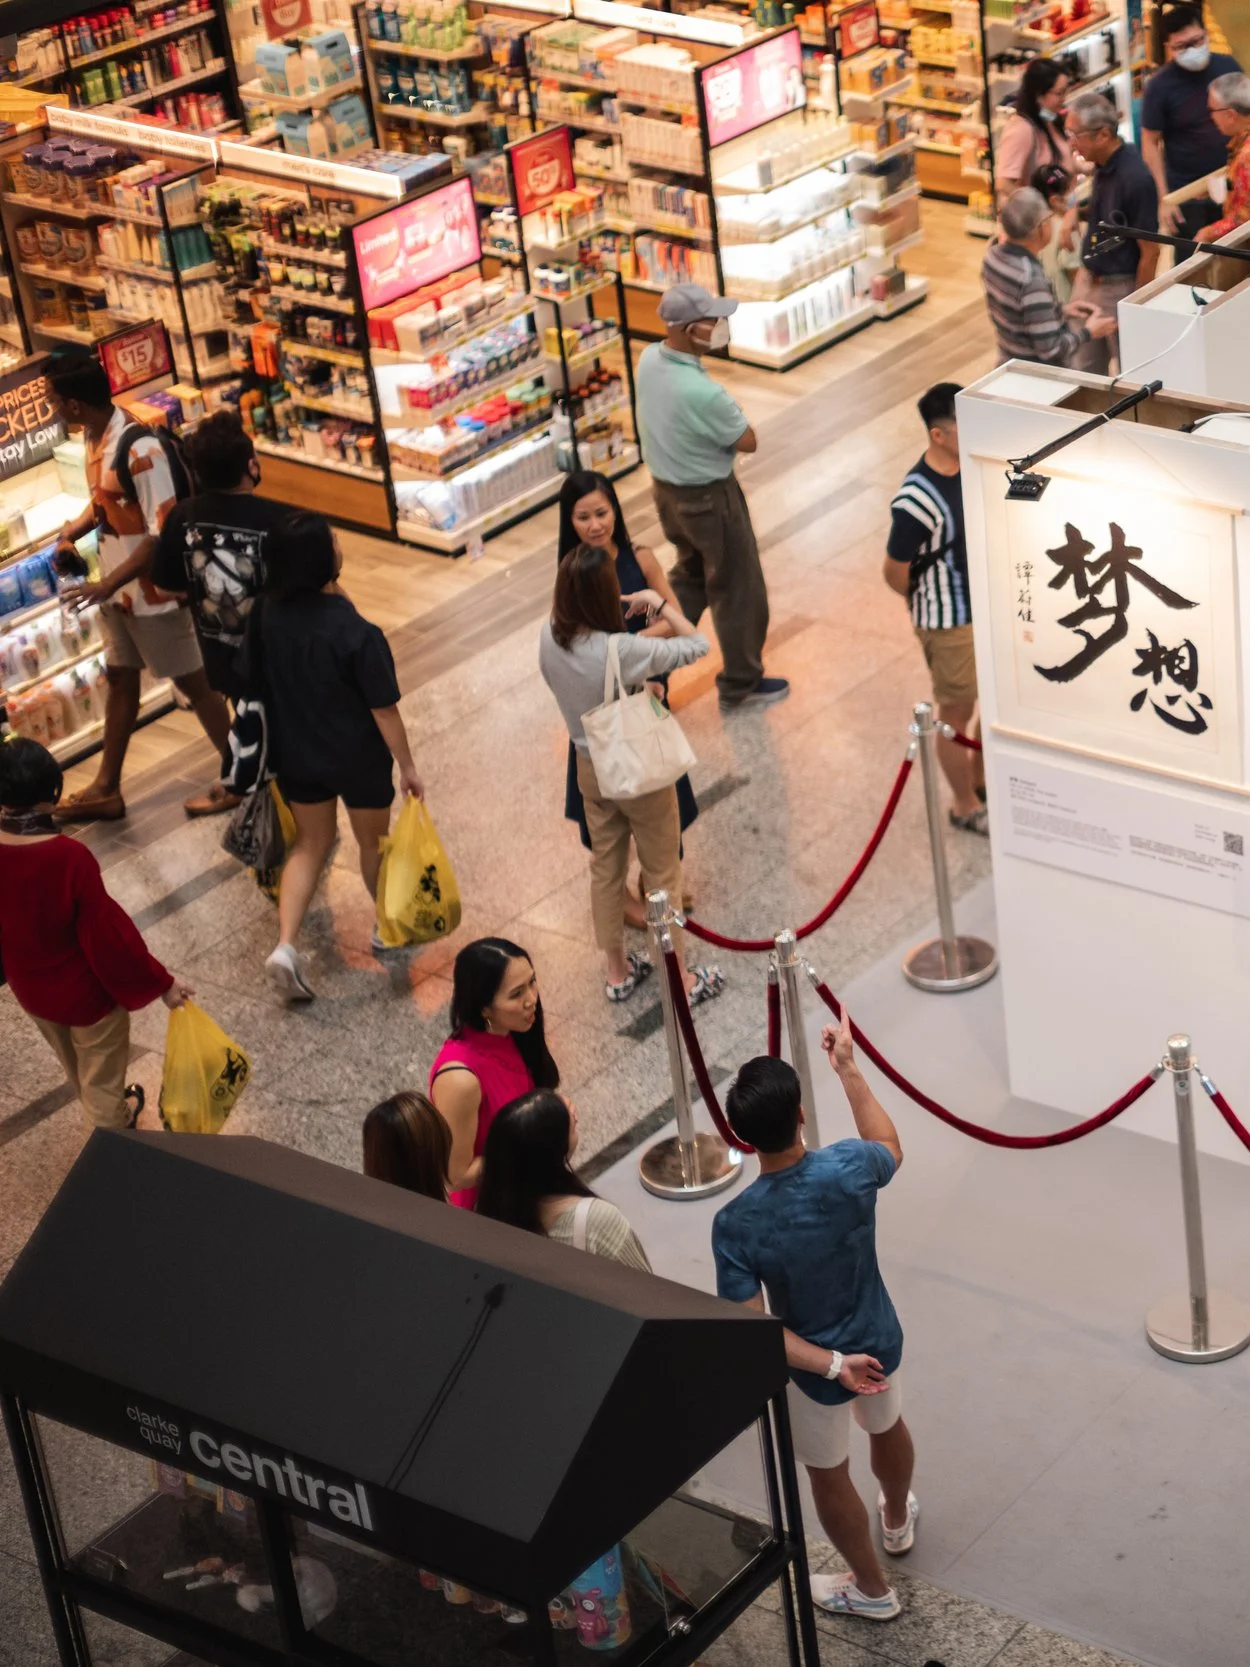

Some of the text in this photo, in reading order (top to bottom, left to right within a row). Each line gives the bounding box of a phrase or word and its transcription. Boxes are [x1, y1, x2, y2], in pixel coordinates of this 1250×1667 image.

[122, 344, 147, 366] $15
[26, 423, 58, 450] Low
[126, 1405, 180, 1437] clarke
[140, 1425, 183, 1455] quay
[189, 1431, 374, 1532] central
